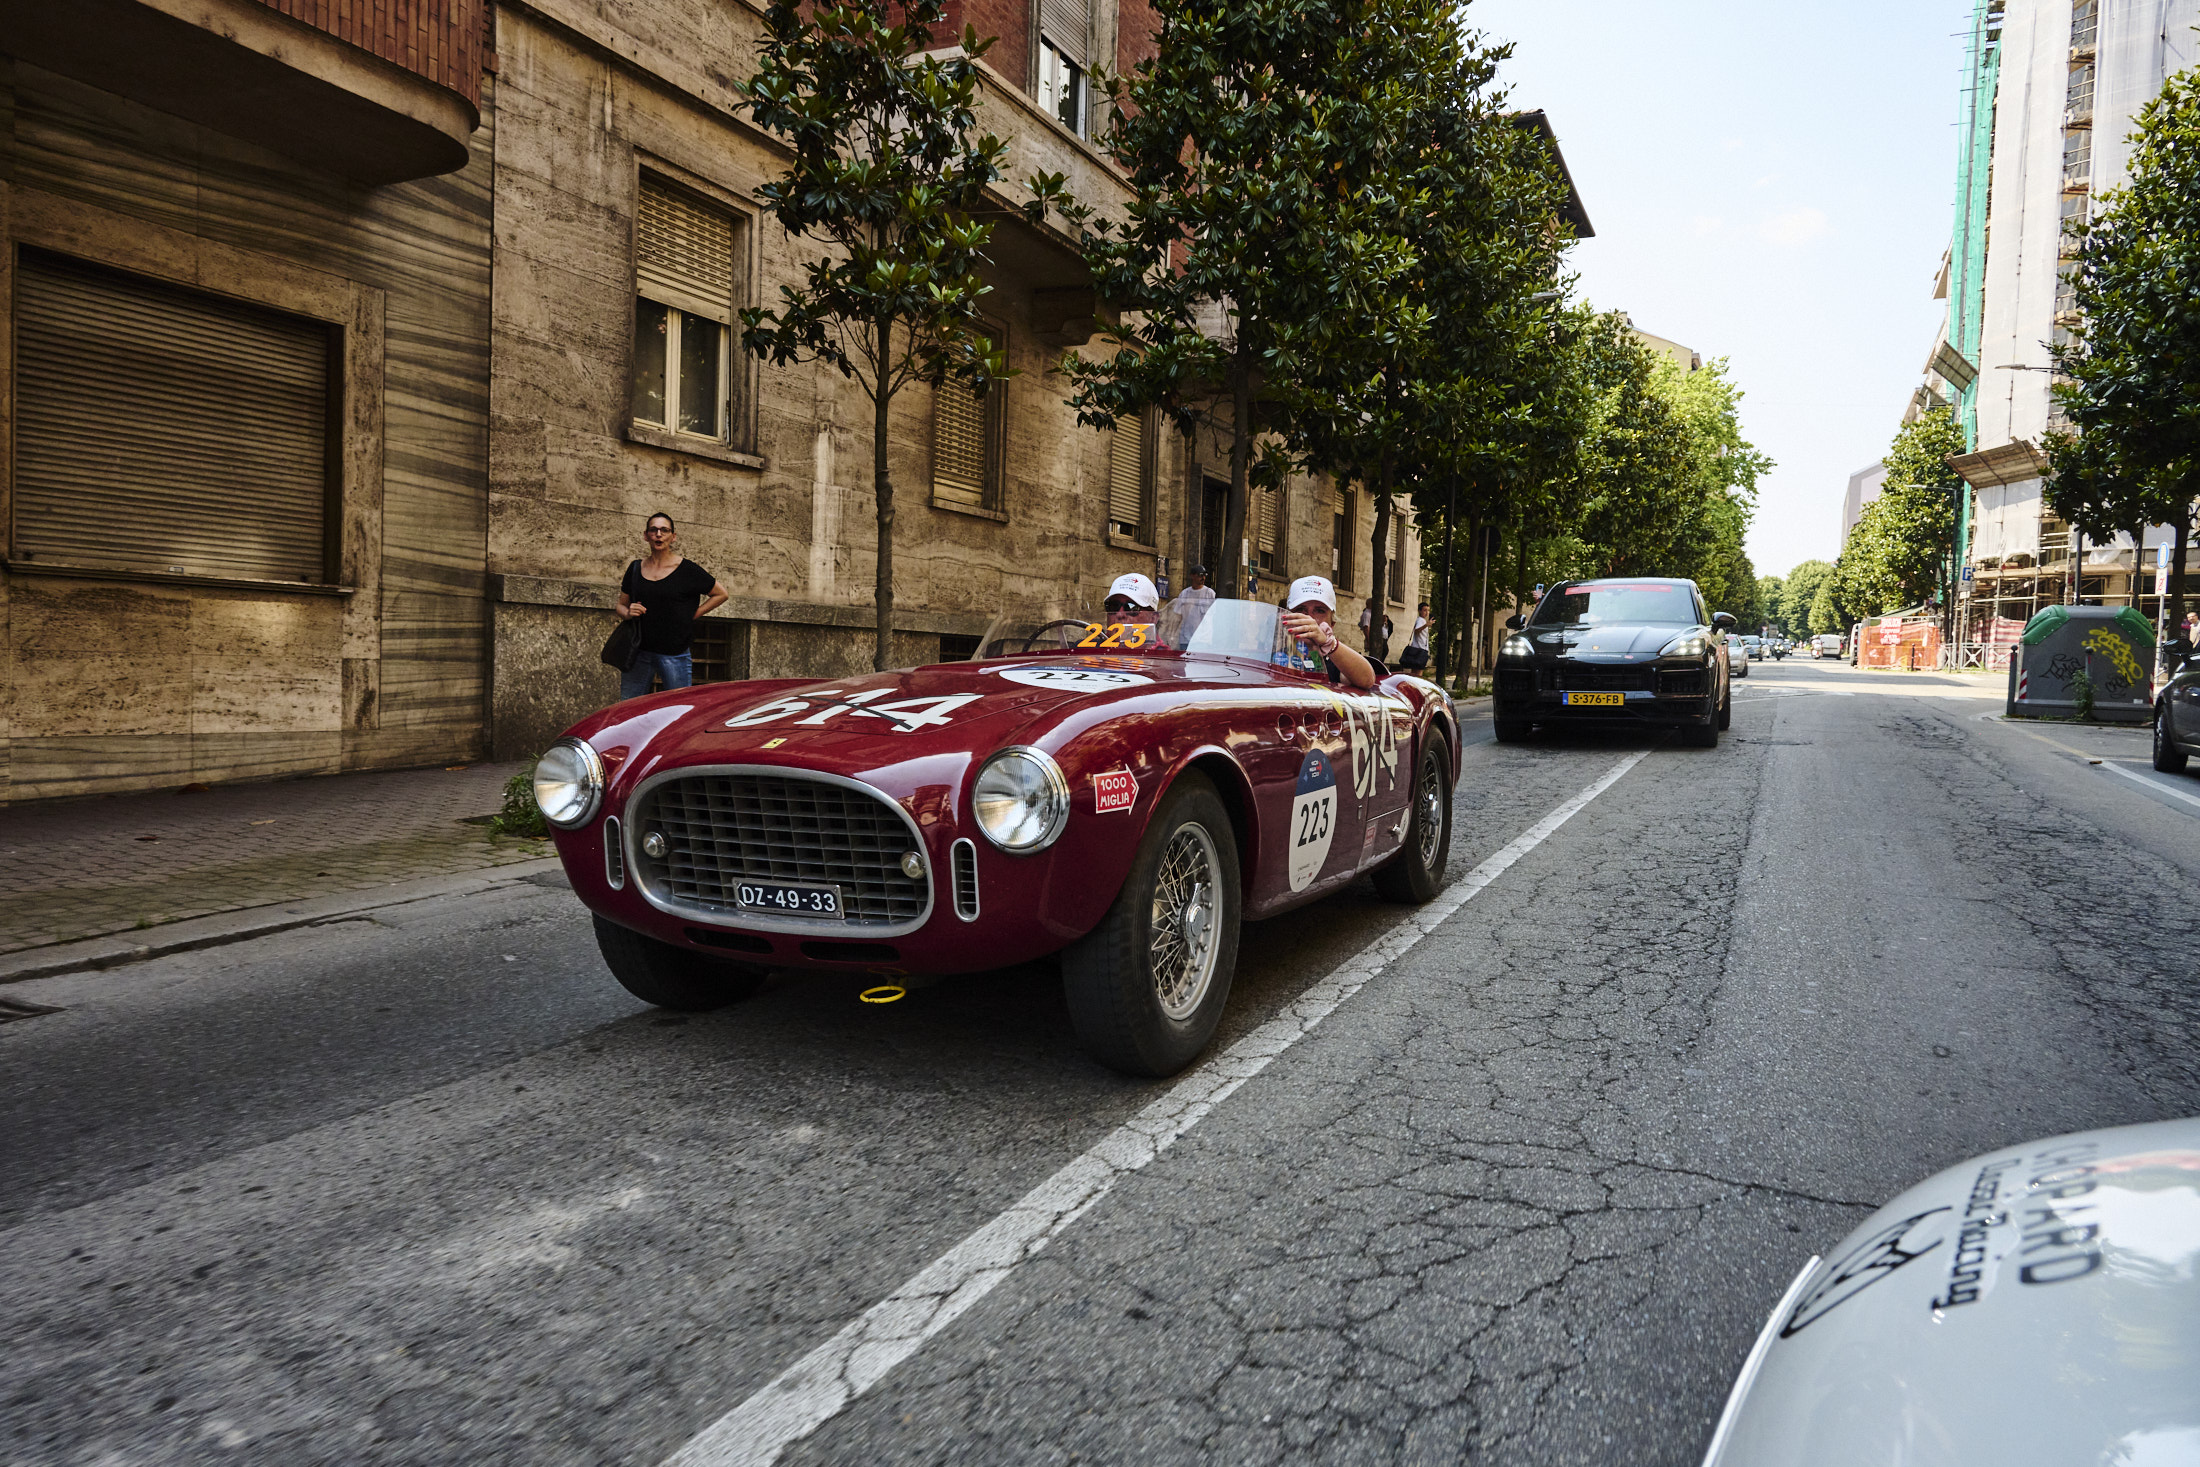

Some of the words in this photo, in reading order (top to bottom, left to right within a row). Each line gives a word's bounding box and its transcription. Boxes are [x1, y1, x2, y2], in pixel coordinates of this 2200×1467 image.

[1077, 623, 1150, 648] 223
[1028, 671, 1131, 683] 223
[725, 688, 984, 732] 614
[1345, 692, 1398, 799] 614
[1100, 792, 1129, 807] MIGLIA
[1101, 776, 1127, 791] 1000
[1297, 797, 1330, 847] 223
[741, 886, 836, 912] DZ-49-33
[2019, 1141, 2104, 1285] CHOPARD
[1931, 1210, 2009, 1311] Racing
